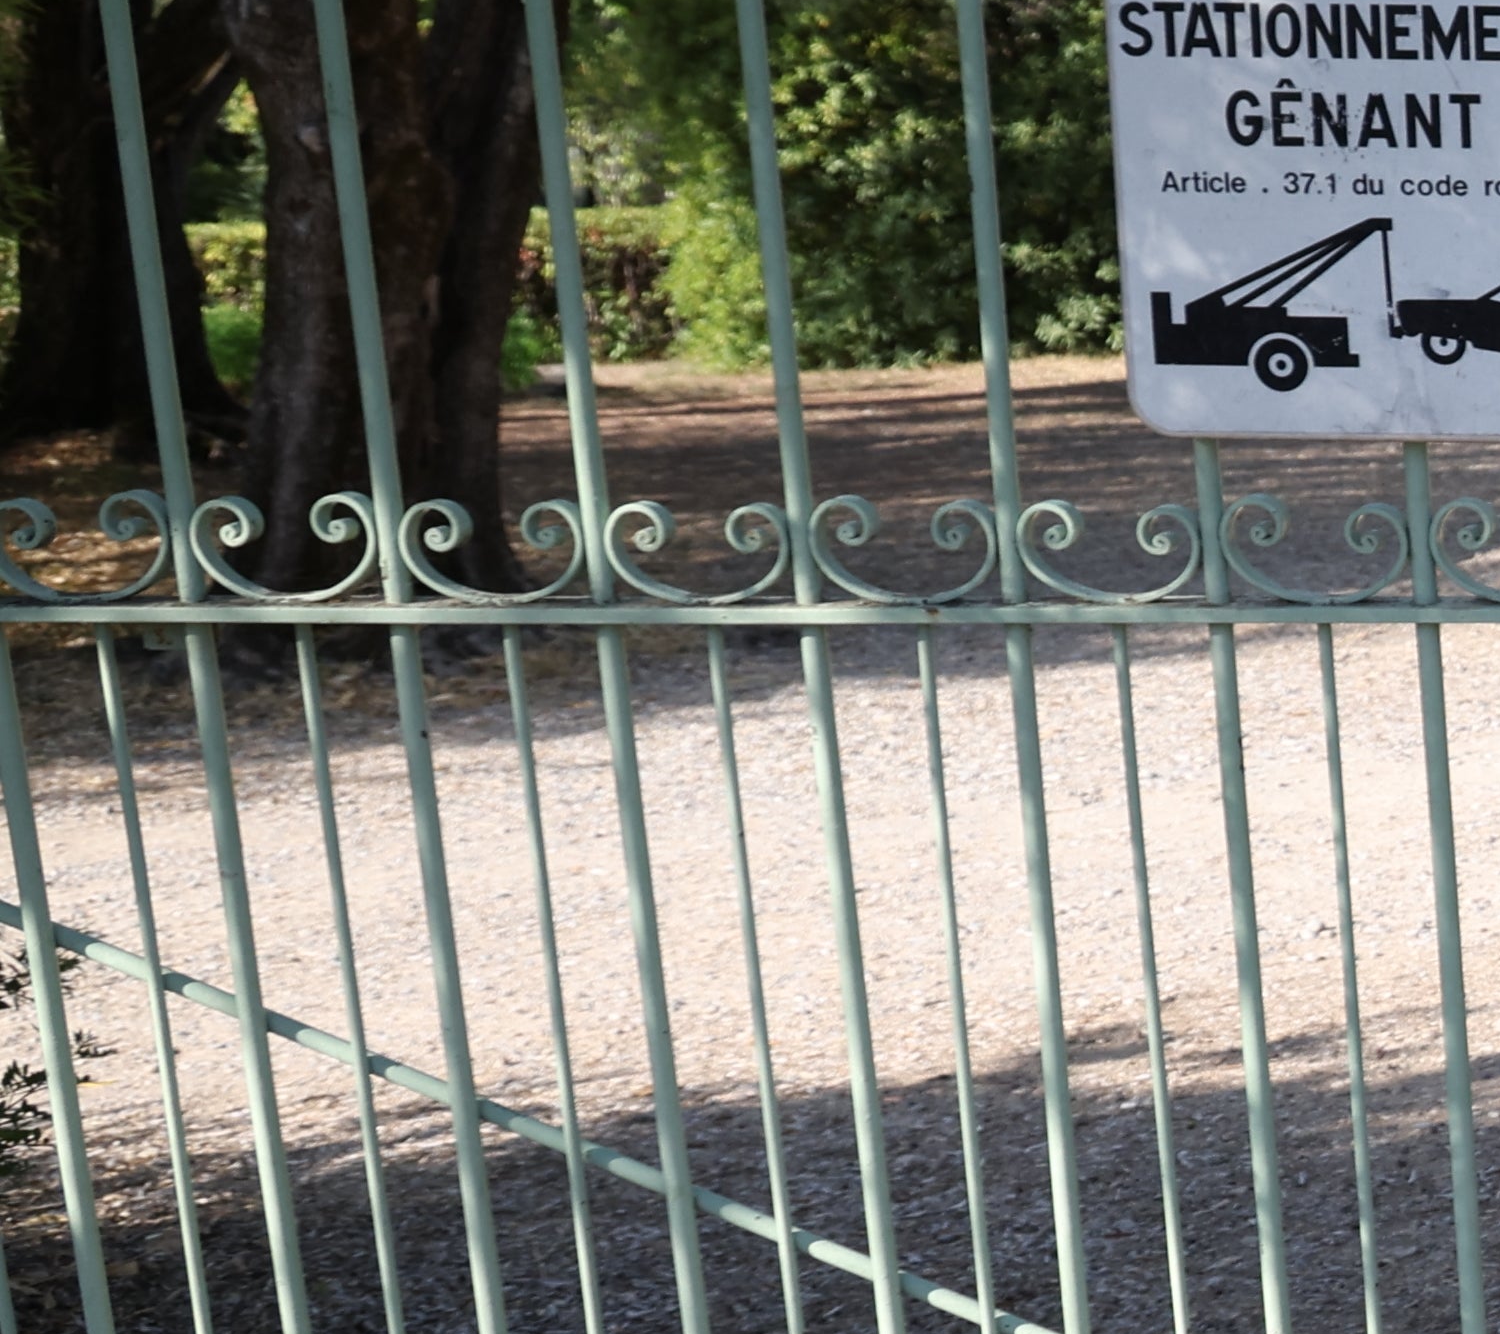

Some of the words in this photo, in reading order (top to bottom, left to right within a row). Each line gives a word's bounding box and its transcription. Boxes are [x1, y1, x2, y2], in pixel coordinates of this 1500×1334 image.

[1225, 78, 1481, 149] GÊNANT
[1161, 171, 1247, 194] Article
[1283, 172, 1338, 195] 37.1
[1352, 173, 1385, 196] du
[1399, 174, 1469, 197] code
